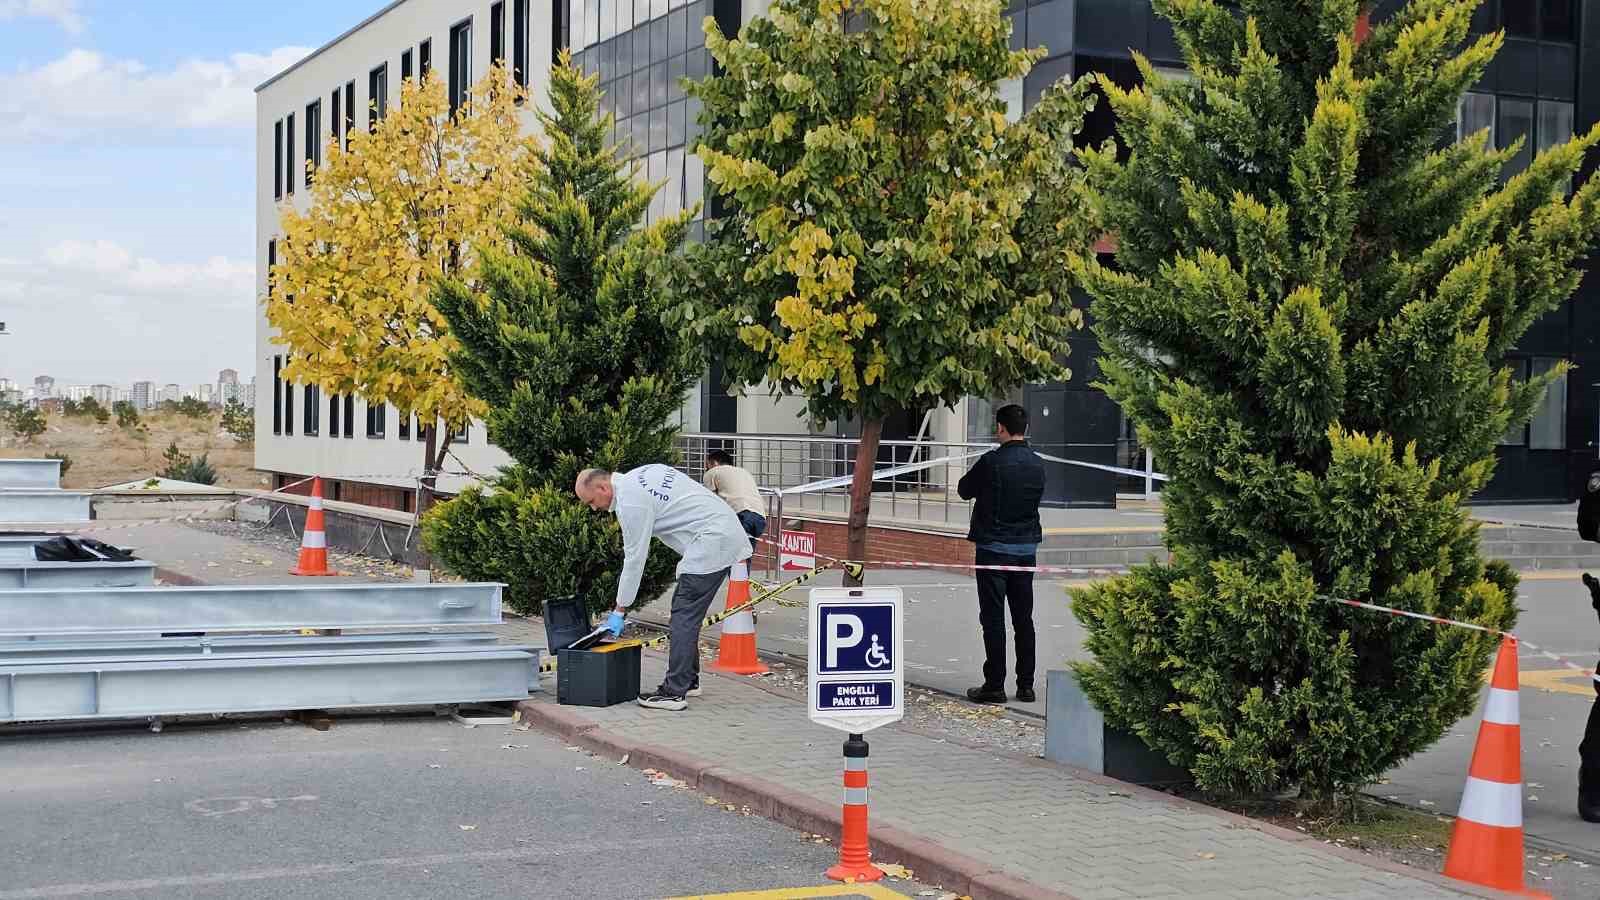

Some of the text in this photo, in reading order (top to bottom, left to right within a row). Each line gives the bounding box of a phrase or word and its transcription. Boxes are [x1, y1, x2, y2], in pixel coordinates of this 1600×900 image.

[647, 487, 669, 501] OLAY
[826, 613, 864, 668] P
[837, 684, 875, 696] ENGELLİ
[832, 695, 880, 707] PARK YERİ
